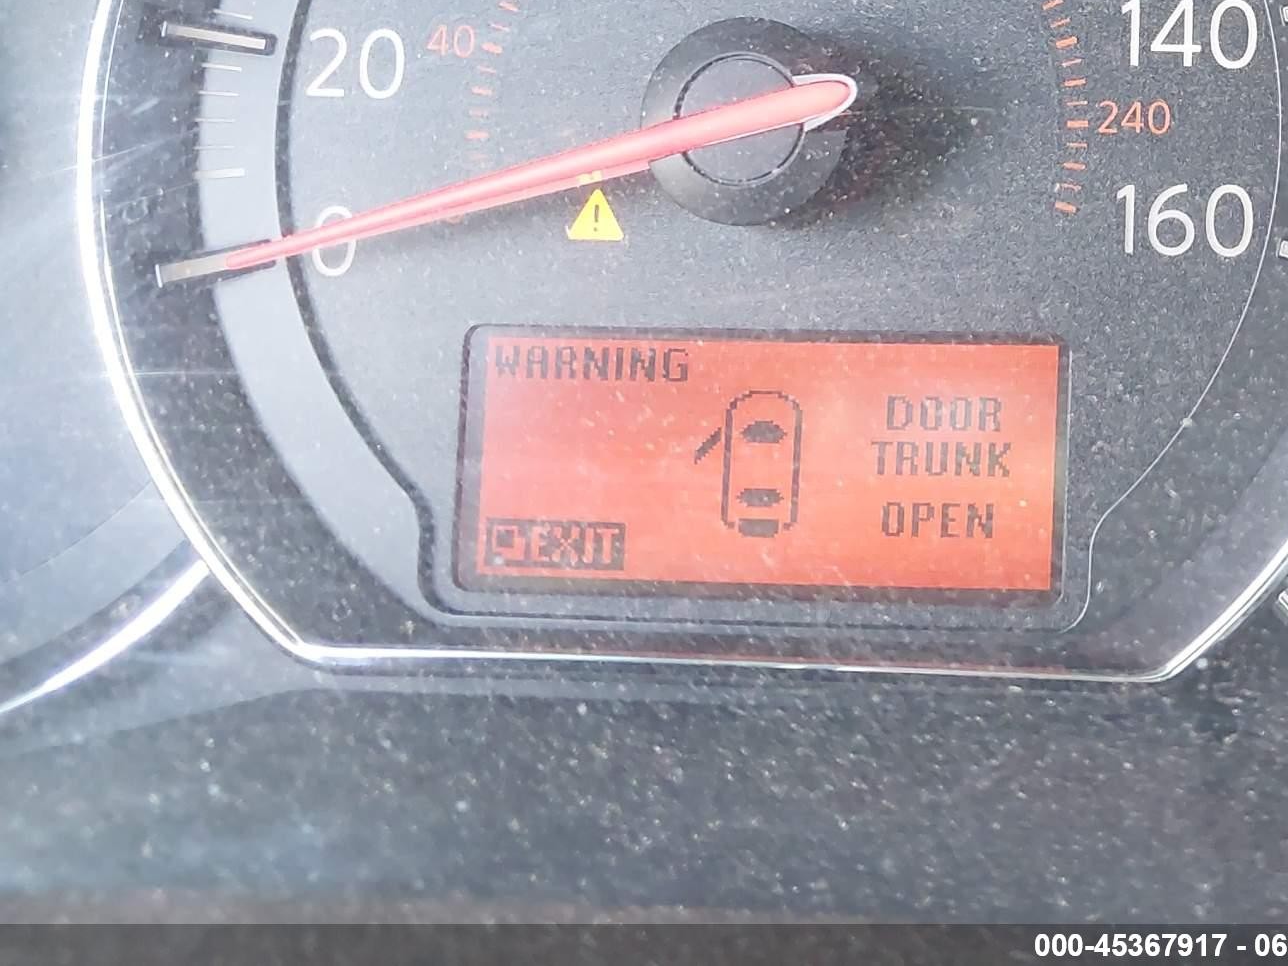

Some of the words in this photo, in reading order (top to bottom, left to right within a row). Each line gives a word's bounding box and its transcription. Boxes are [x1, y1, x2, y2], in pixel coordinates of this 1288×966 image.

[426, 24, 476, 57] 40
[305, 28, 406, 100] 20
[1097, 100, 1171, 135] 240
[1115, 183, 1254, 258] 160
[311, 205, 357, 277] 0
[494, 345, 690, 383] WARNING
[887, 396, 1003, 433] DOOR
[872, 441, 1012, 478] TRUNK
[882, 502, 995, 539] OPEN
[530, 525, 620, 565] EXIT
